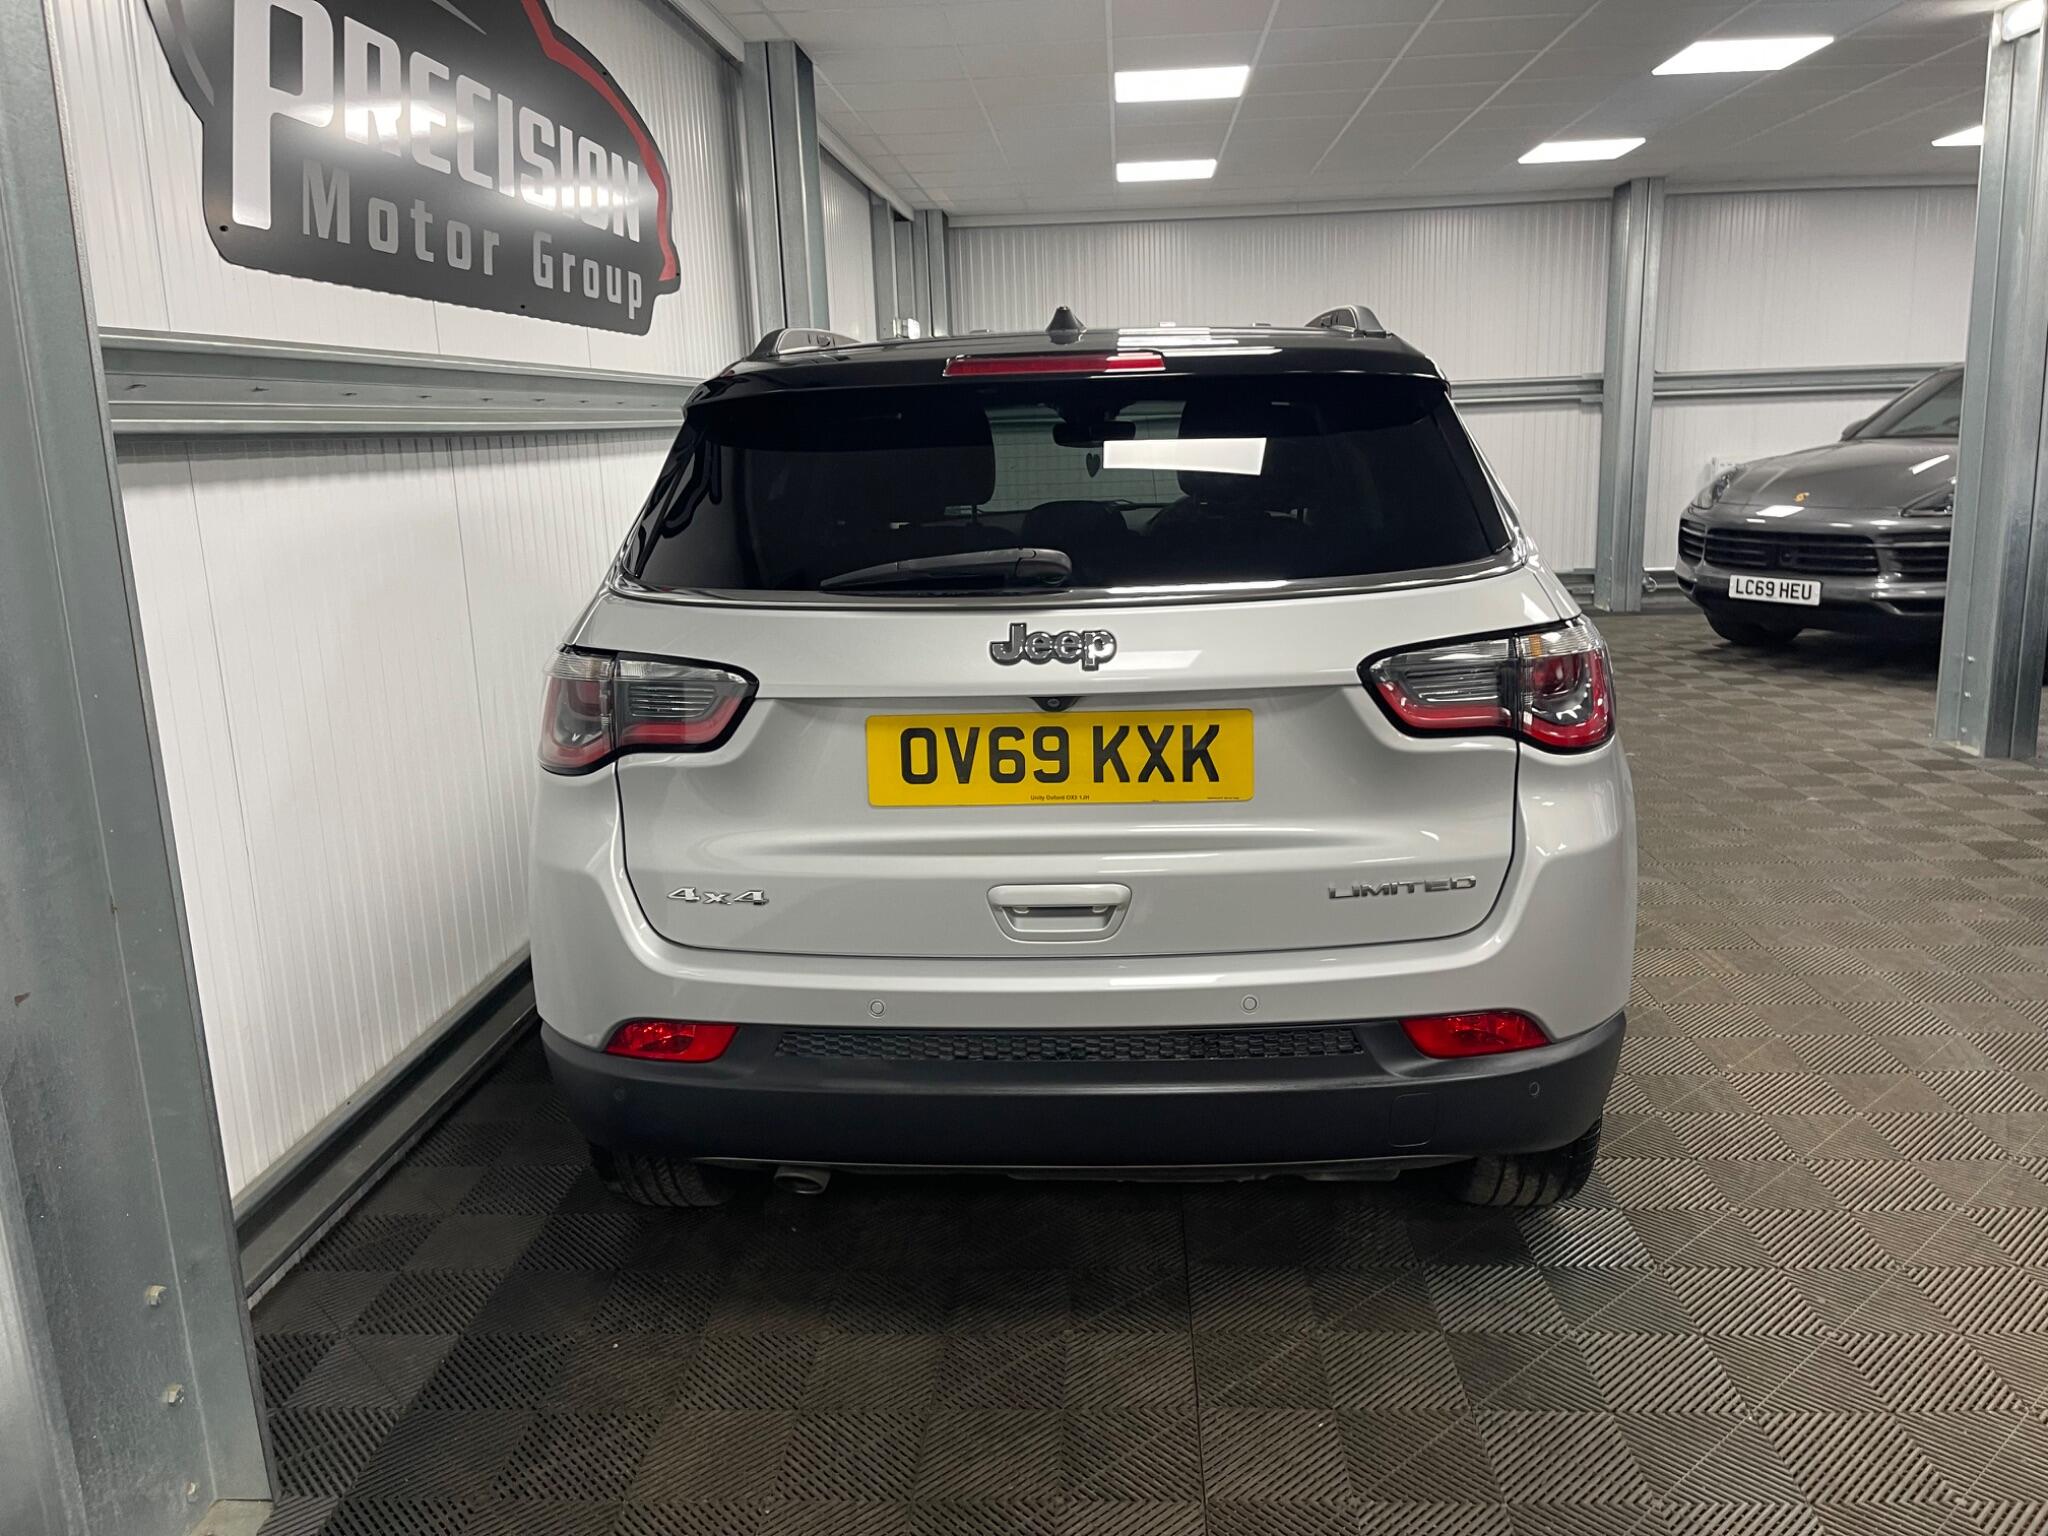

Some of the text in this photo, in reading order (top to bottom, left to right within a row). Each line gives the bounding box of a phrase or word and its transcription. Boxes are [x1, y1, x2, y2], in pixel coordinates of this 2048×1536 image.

[232, 0, 640, 243] PRECISION
[303, 159, 643, 320] Motor Group
[1735, 578, 1812, 600] LC69 HEU
[989, 622, 1118, 671] Jeep
[900, 723, 1220, 785] OV69 KXK
[666, 886, 769, 905] 4x4
[1328, 875, 1477, 899] LIMITED
